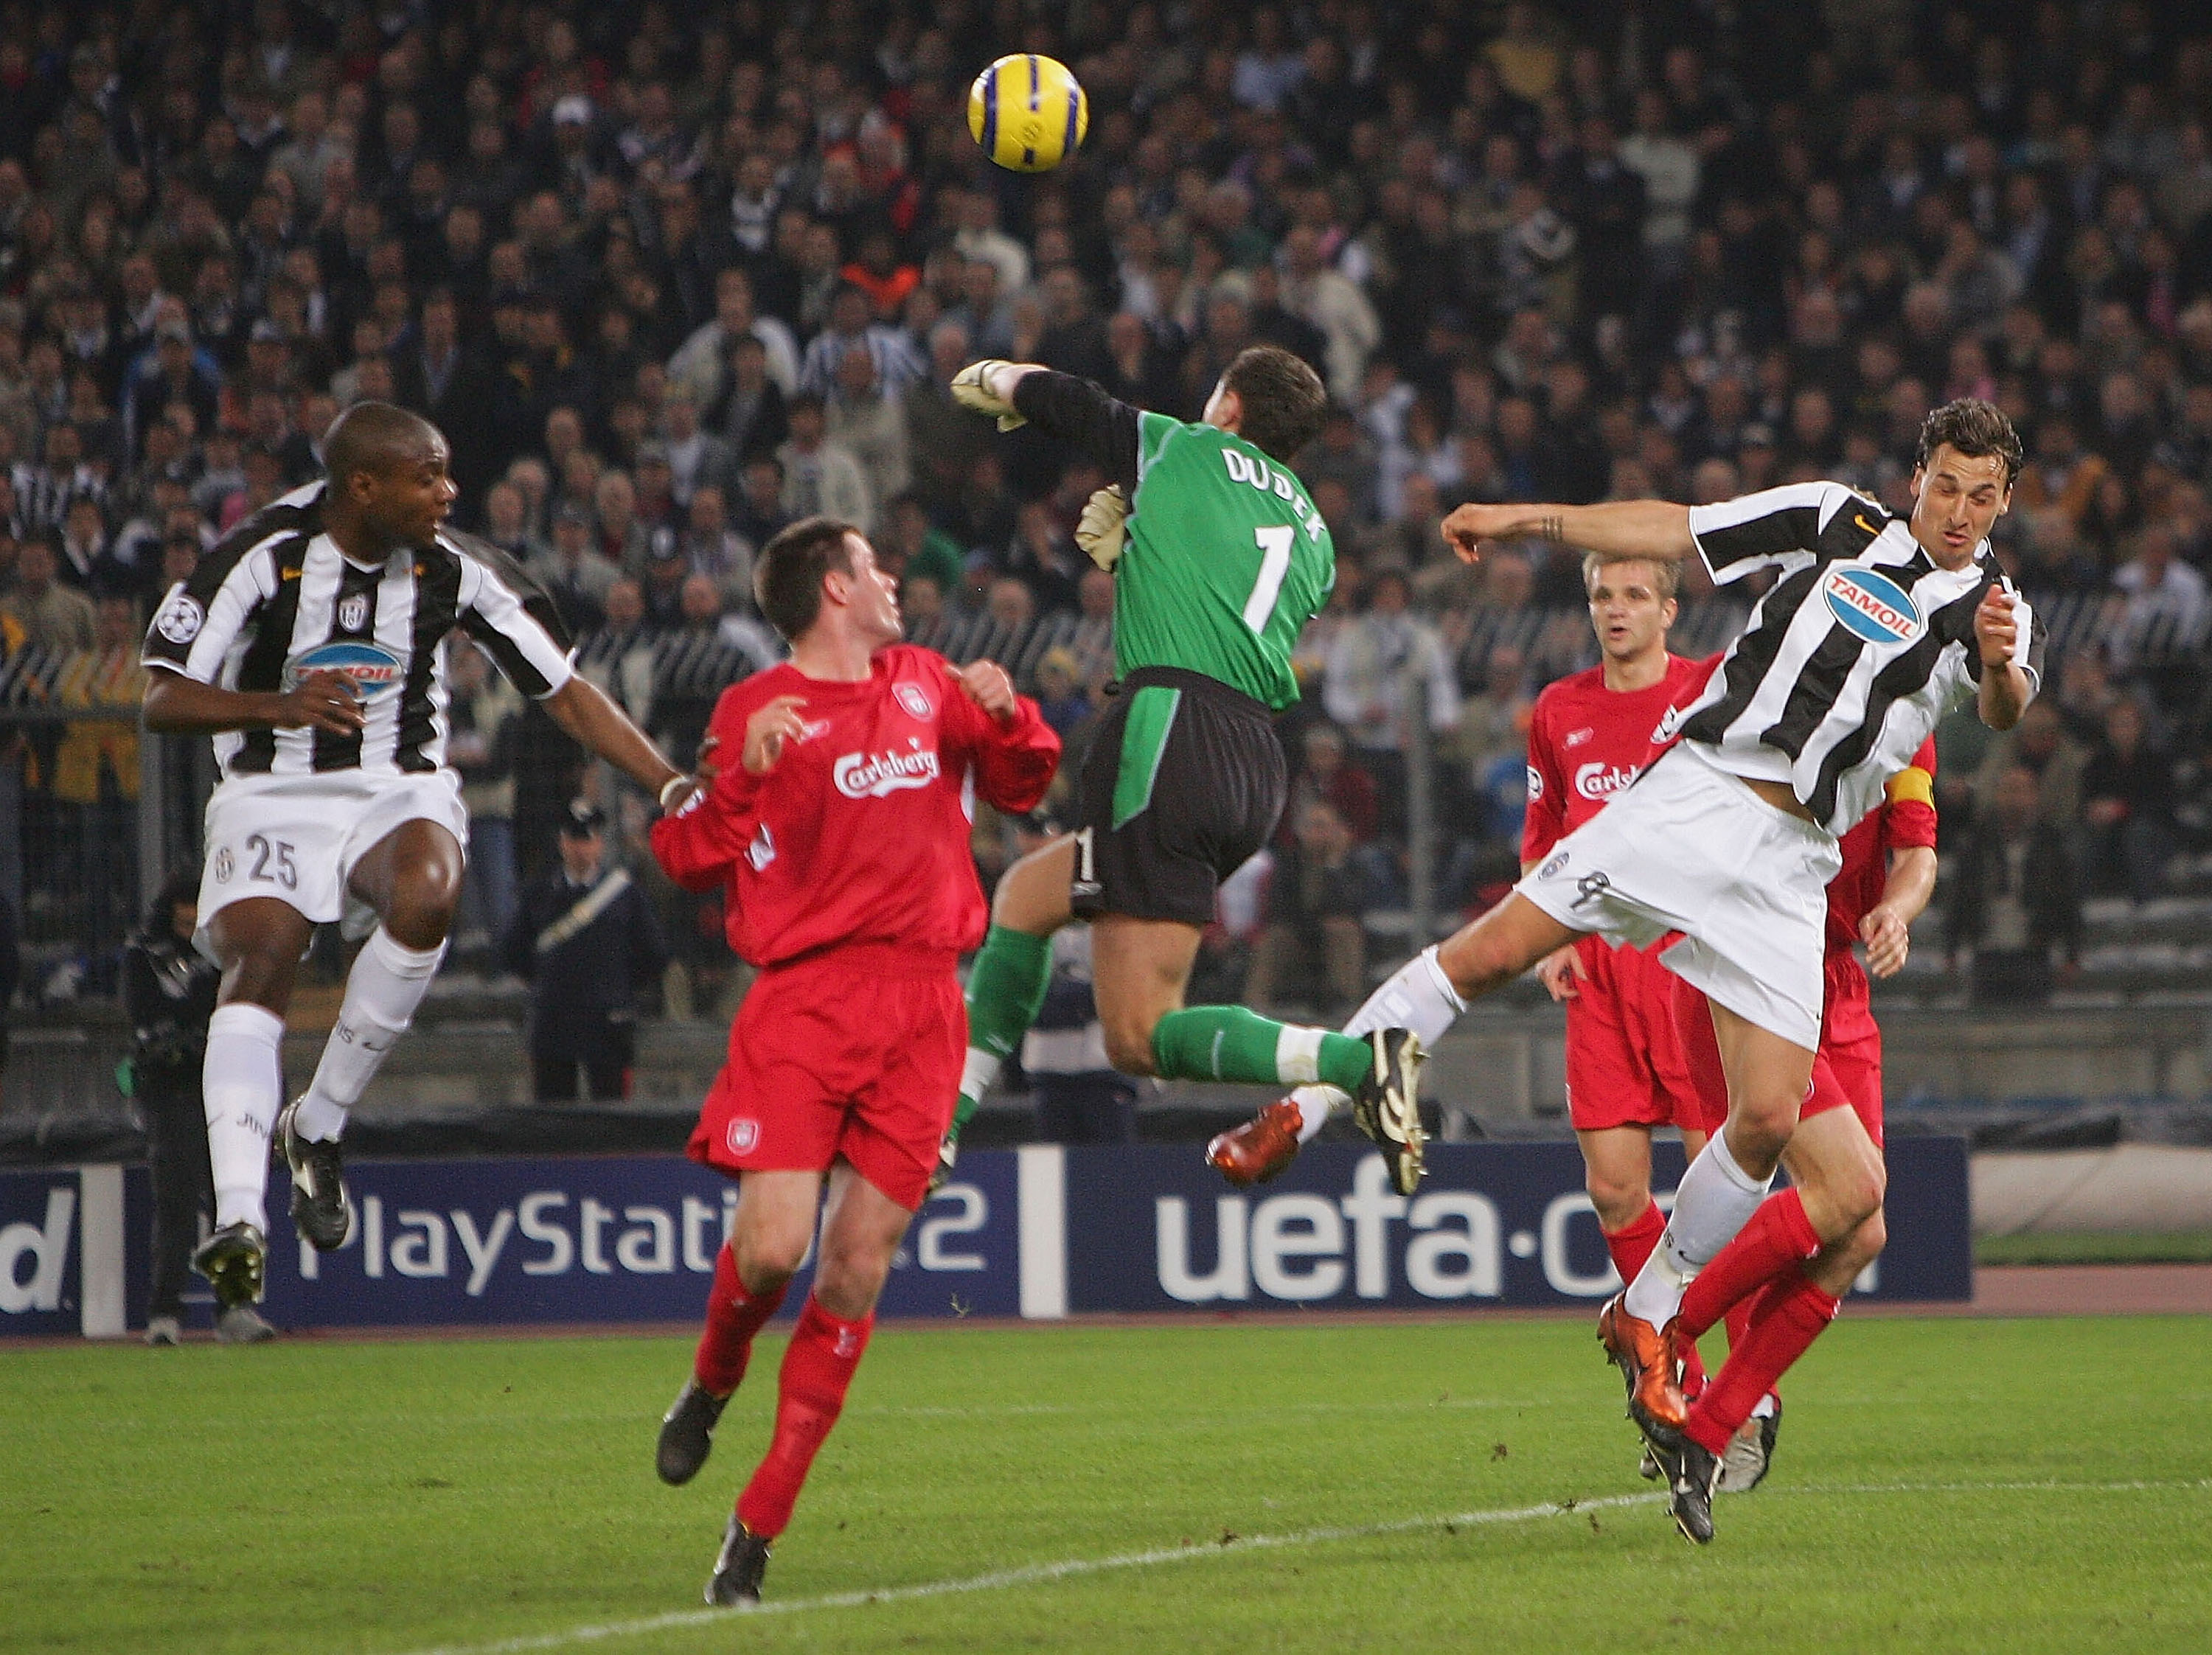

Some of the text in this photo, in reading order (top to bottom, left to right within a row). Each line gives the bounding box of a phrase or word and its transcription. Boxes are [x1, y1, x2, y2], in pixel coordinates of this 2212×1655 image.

[1220, 448, 1326, 544] DUDEK
[1242, 525, 1295, 635] 1
[1830, 575, 1913, 639] TAMOIL
[833, 736, 940, 798] Carlsberg
[246, 834, 298, 891] 25
[1076, 826, 1093, 882] 1
[918, 1182, 989, 1272] 2
